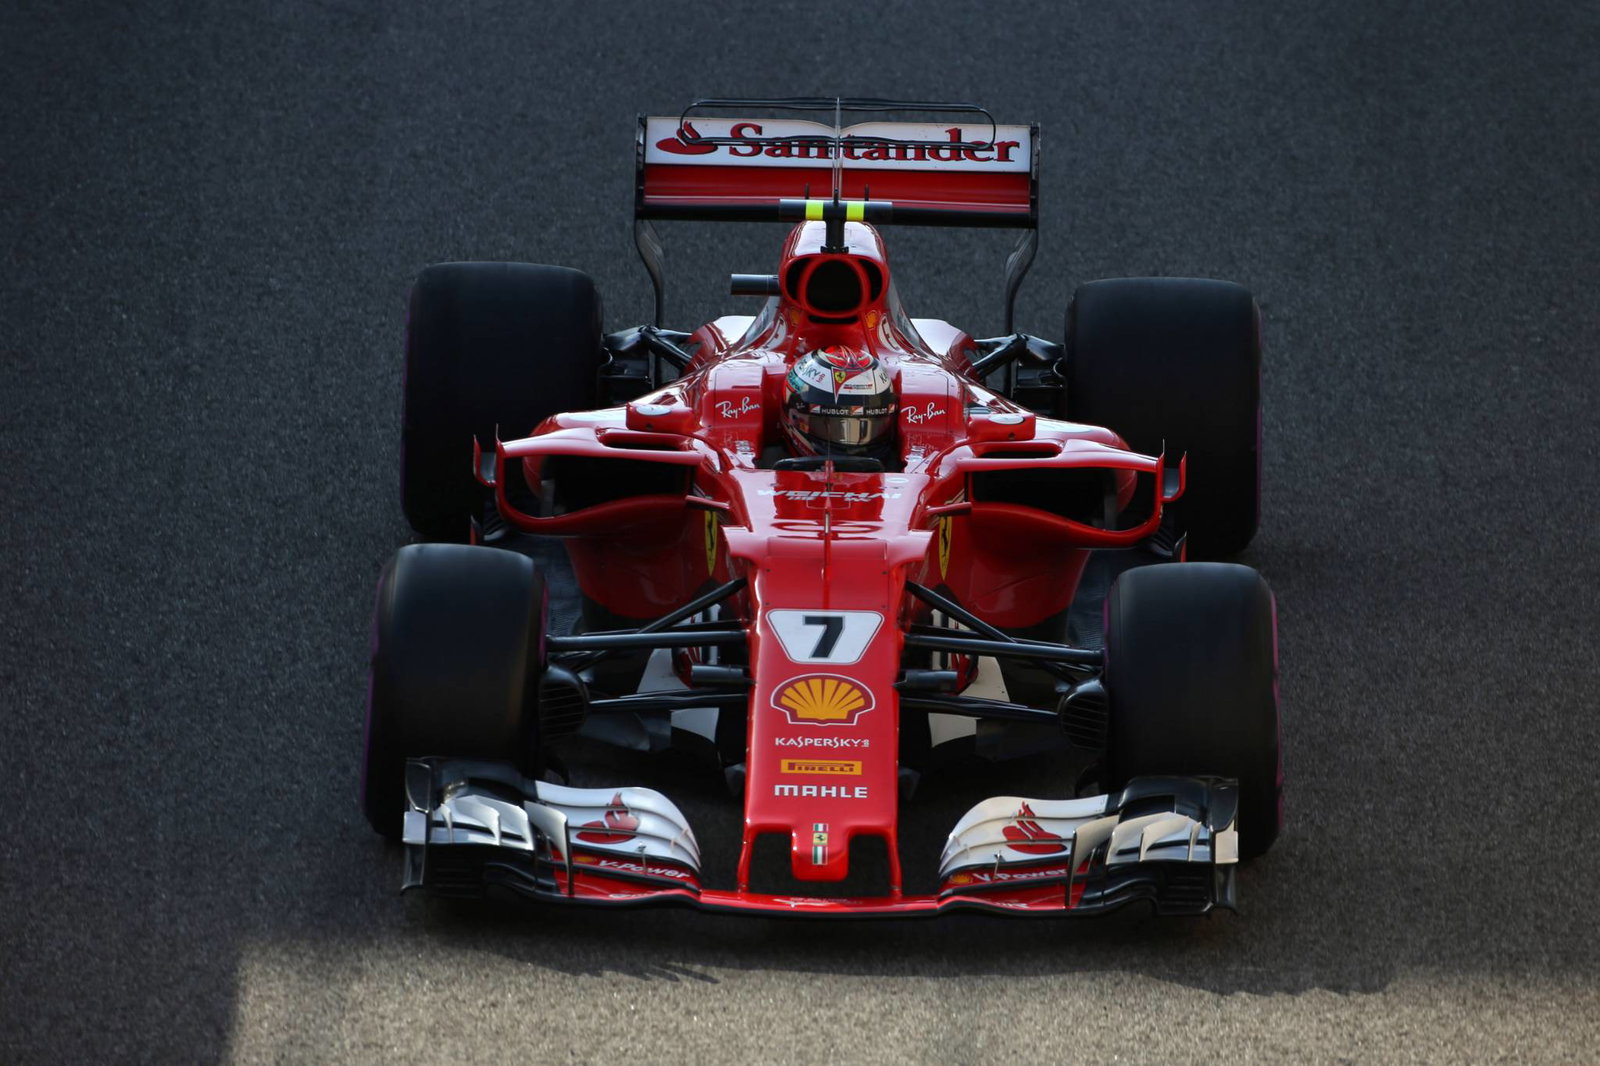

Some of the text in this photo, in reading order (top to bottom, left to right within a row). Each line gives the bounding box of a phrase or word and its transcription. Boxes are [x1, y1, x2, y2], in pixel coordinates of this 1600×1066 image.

[729, 122, 1020, 162] Santander
[866, 407, 888, 415] HUBLOT
[803, 615, 846, 659] 7
[775, 736, 861, 748] KASPERSKY
[788, 762, 855, 772] PIRELLI
[774, 784, 868, 798] MAHLE
[599, 860, 691, 878] V-Power
